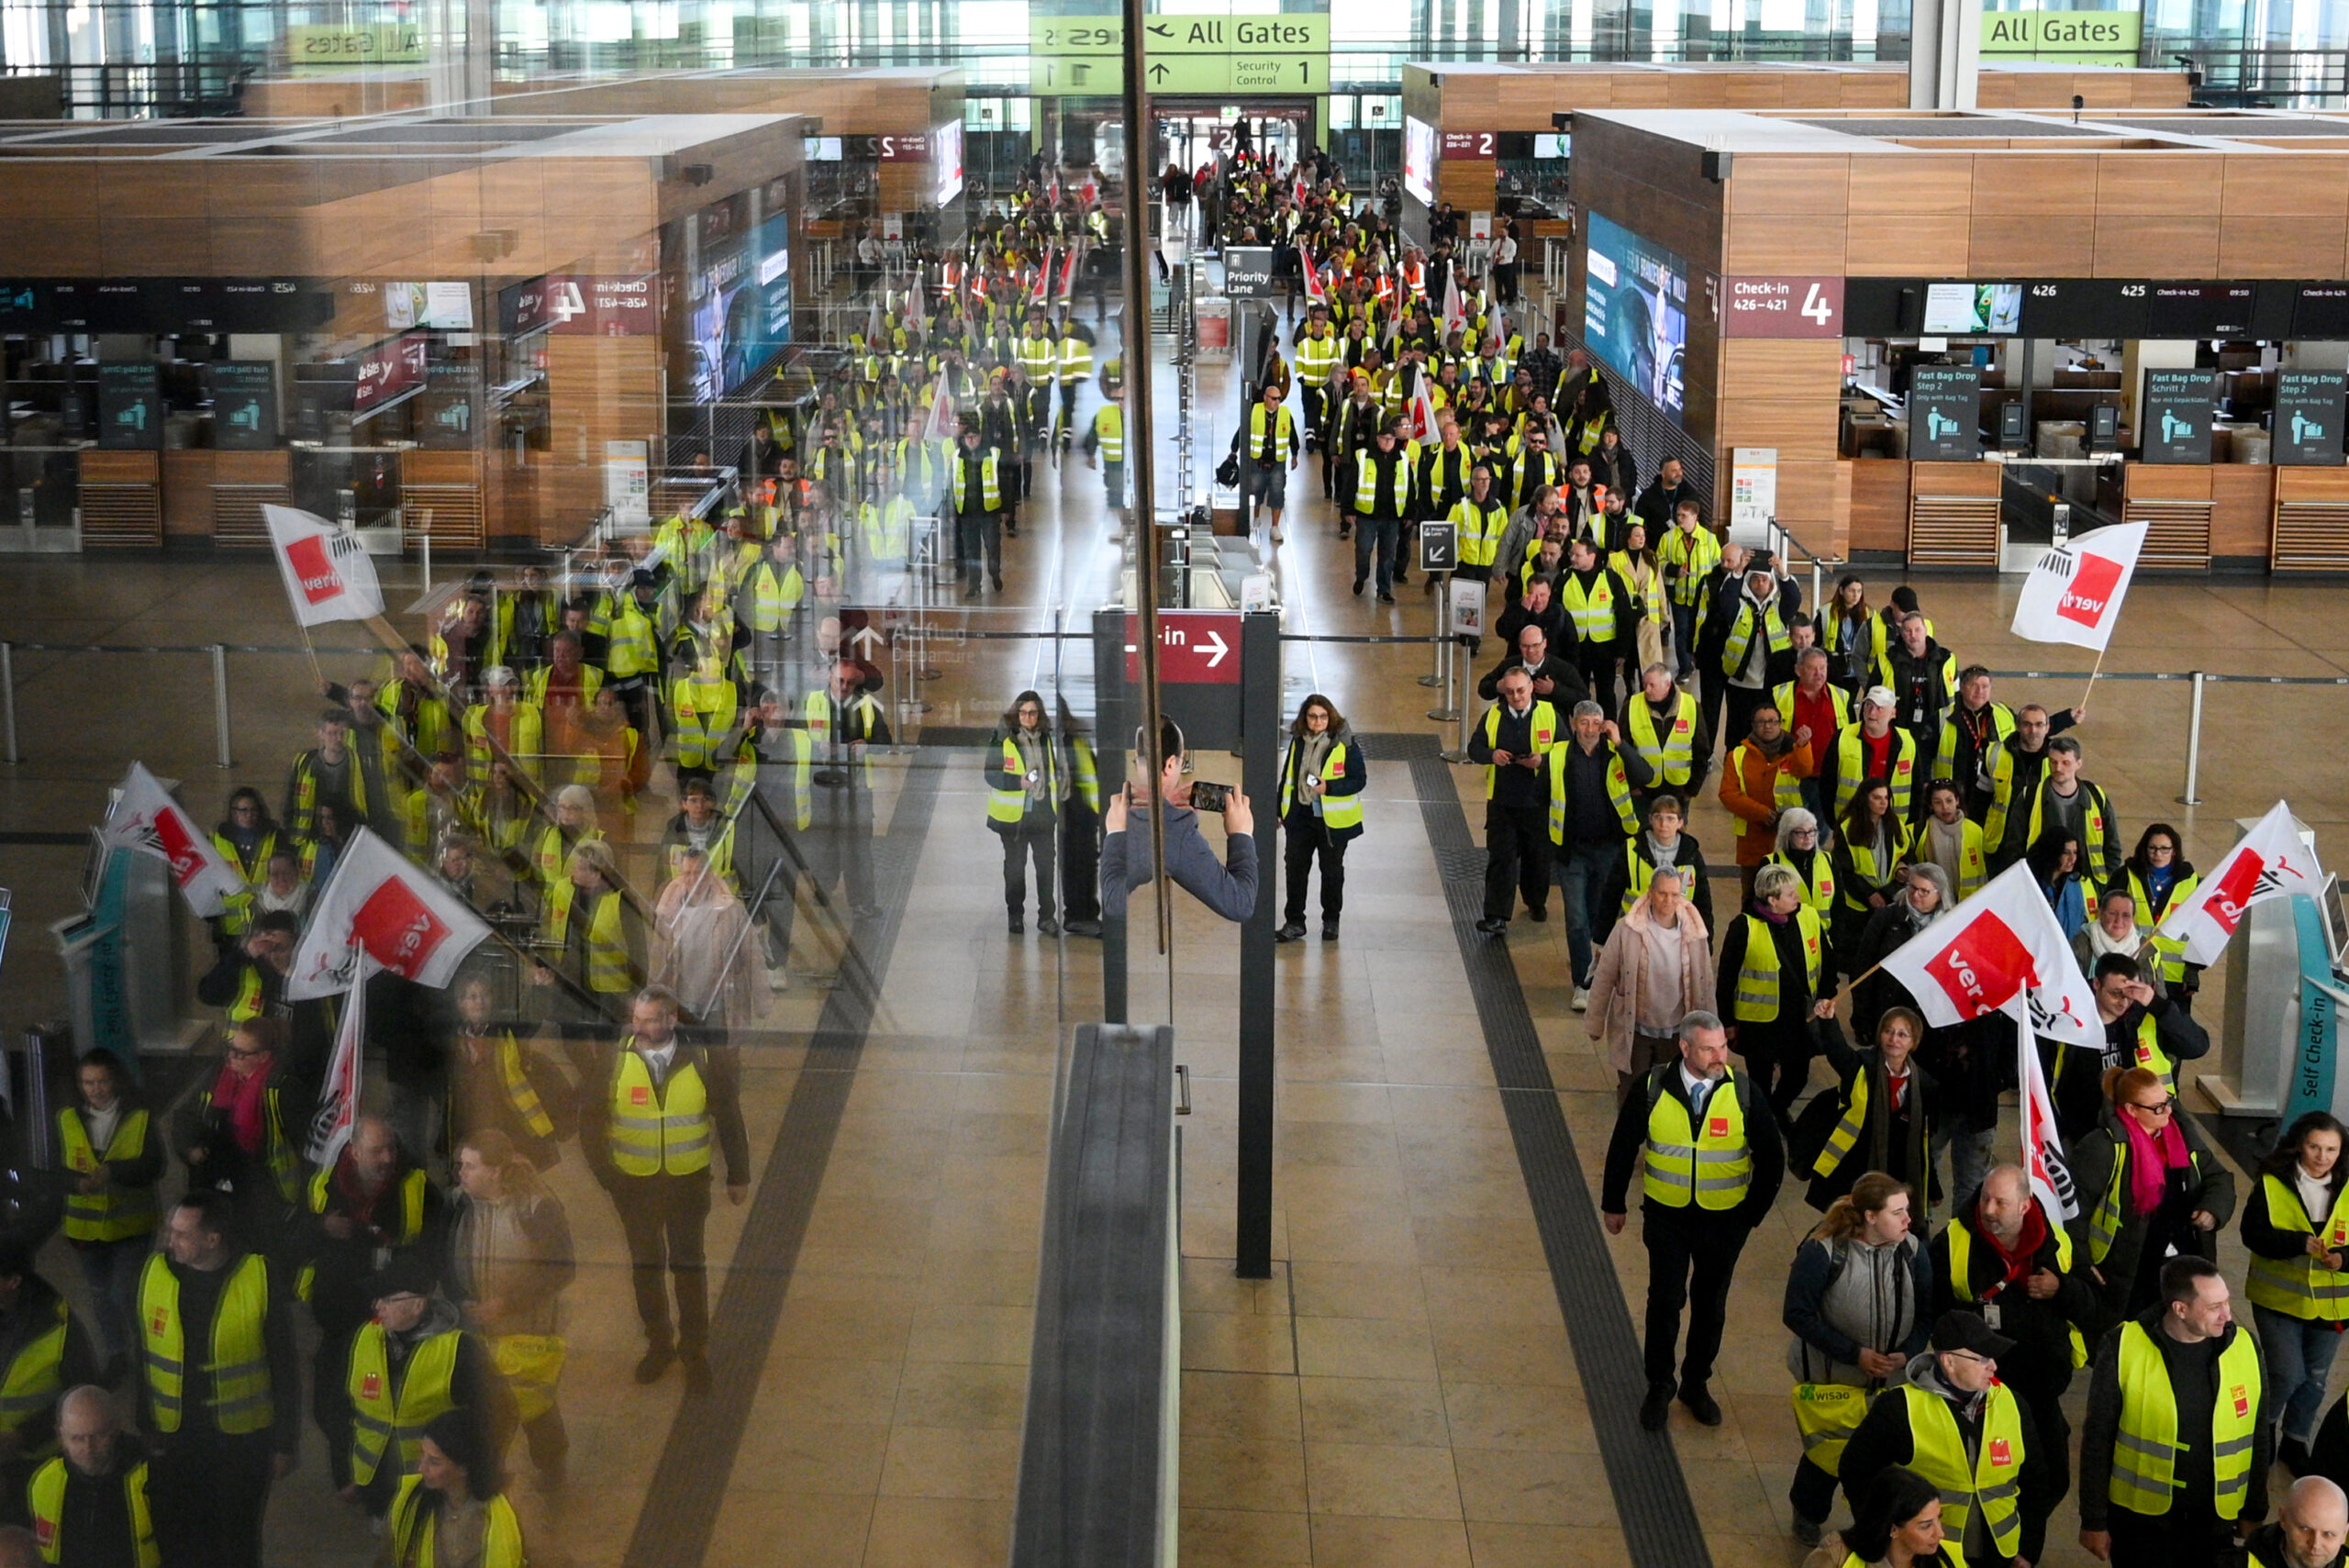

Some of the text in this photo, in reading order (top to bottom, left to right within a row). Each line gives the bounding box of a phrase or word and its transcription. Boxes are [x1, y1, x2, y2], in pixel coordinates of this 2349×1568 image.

[1187, 21, 1310, 44] All Gates
[1991, 18, 2121, 42] All Gates
[1237, 61, 1281, 72] Security
[1298, 61, 1308, 84] 1
[1236, 75, 1277, 85] Control
[1219, 129, 1232, 150] 2
[1478, 133, 1493, 155] 2
[1227, 272, 1269, 285] Priority
[1227, 284, 1253, 295] Lane
[1734, 282, 1789, 295] Check-in
[2032, 285, 2057, 296] 426
[2121, 285, 2146, 296] 425
[2303, 289, 2332, 297] Check-in
[1800, 283, 1832, 327] 4
[1917, 372, 1976, 384] Fast Bag Drop
[2152, 373, 2211, 385] Fast Bag Drop
[2281, 374, 2343, 386] Fast Bag Drop
[1917, 382, 1943, 392] Step 2
[2152, 384, 2186, 393] Schritt 2
[2280, 385, 2308, 395] Step 2
[2303, 997, 2325, 1098] Self Check-in
